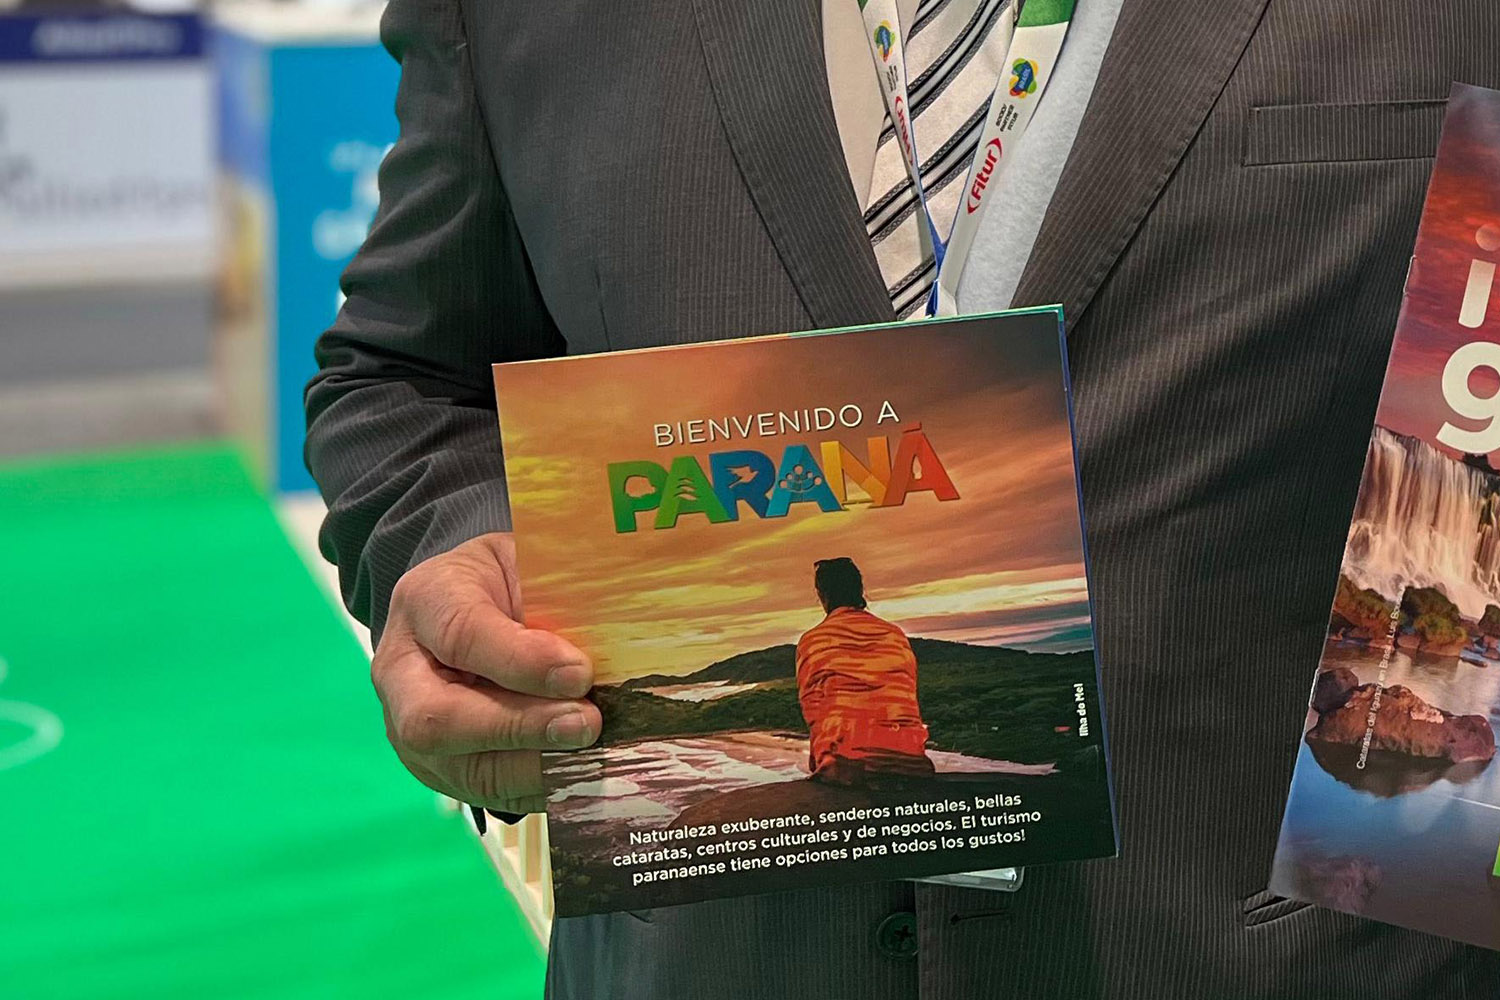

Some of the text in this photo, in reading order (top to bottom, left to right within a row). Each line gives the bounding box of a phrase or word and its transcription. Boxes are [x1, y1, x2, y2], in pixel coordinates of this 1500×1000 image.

[969, 143, 1000, 207] Fitur
[653, 400, 900, 447] BIENVENIDO A
[607, 422, 961, 534] PARANÁ
[1073, 683, 1089, 737] Ilha do Mel
[612, 810, 1041, 867] cataratas, centros culturales y de negocios. El turismo
[629, 794, 1022, 845] Naturaleza exuberante, senderos naturales, bellas
[632, 828, 1026, 886] paranaense tiene opciones para todos los gustos!
